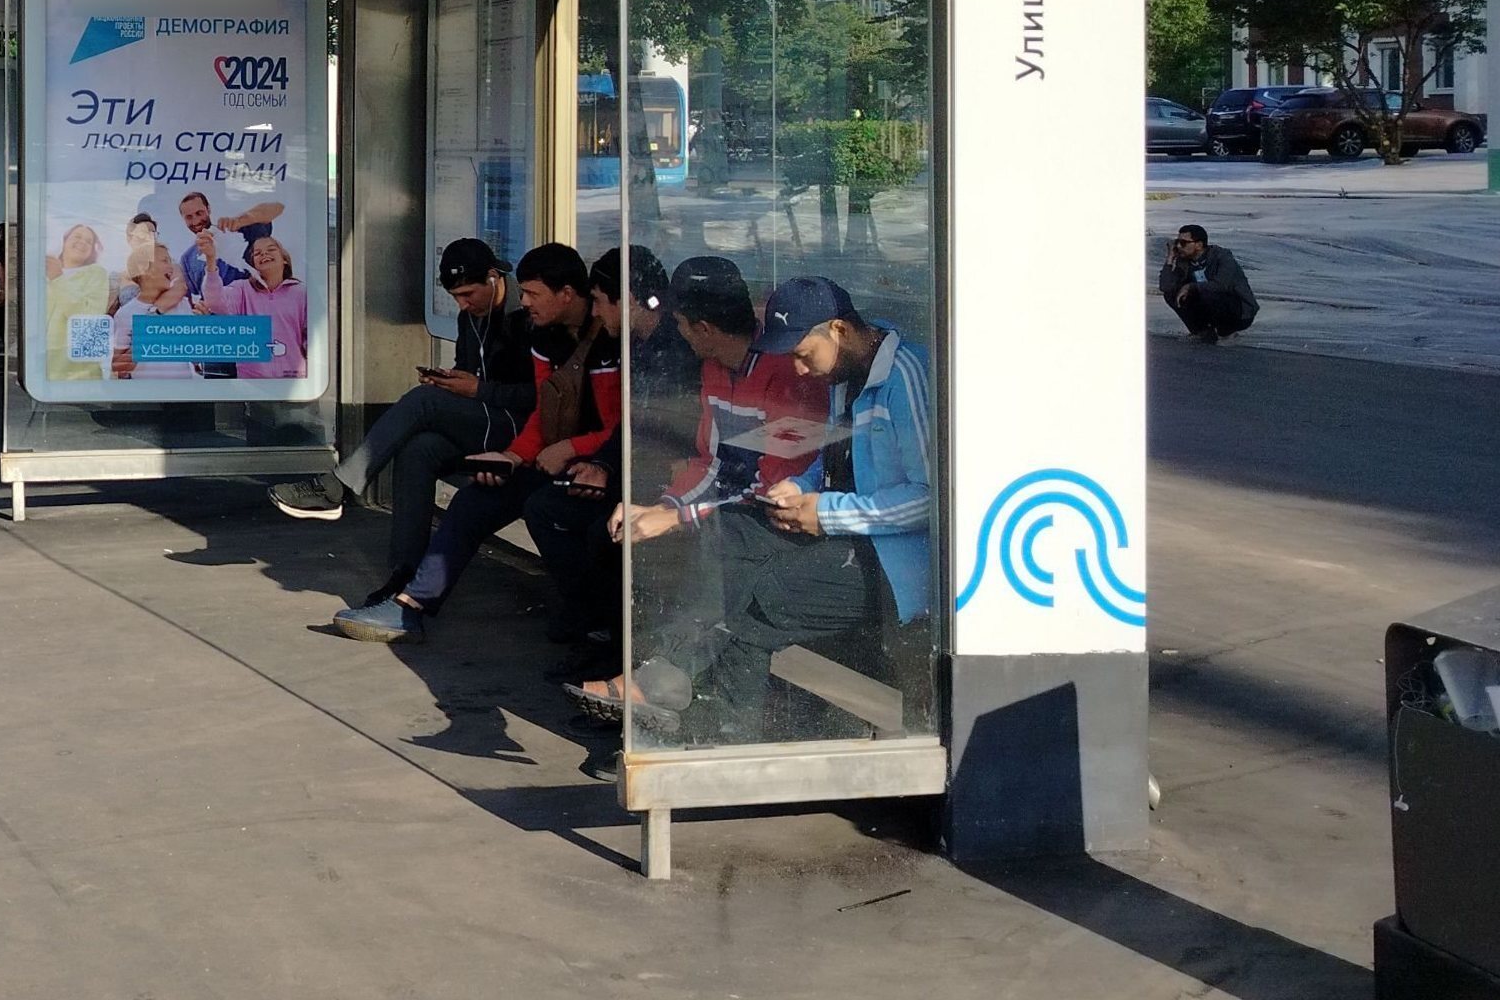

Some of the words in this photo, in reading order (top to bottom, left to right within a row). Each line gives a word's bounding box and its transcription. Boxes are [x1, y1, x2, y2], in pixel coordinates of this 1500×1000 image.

[155, 18, 289, 36] ДЕМОГРАФИЯ
[224, 56, 289, 90] 2024
[66, 89, 155, 125] Эти
[223, 93, 245, 108] ГОД
[82, 133, 163, 152] люди
[174, 131, 283, 153] стали
[125, 160, 288, 185] родными
[145, 325, 226, 335] СТАНОВИТЕСЬ
[227, 325, 237, 335] И
[239, 325, 257, 335] ВЫ
[141, 341, 260, 358] усыновите.рф
